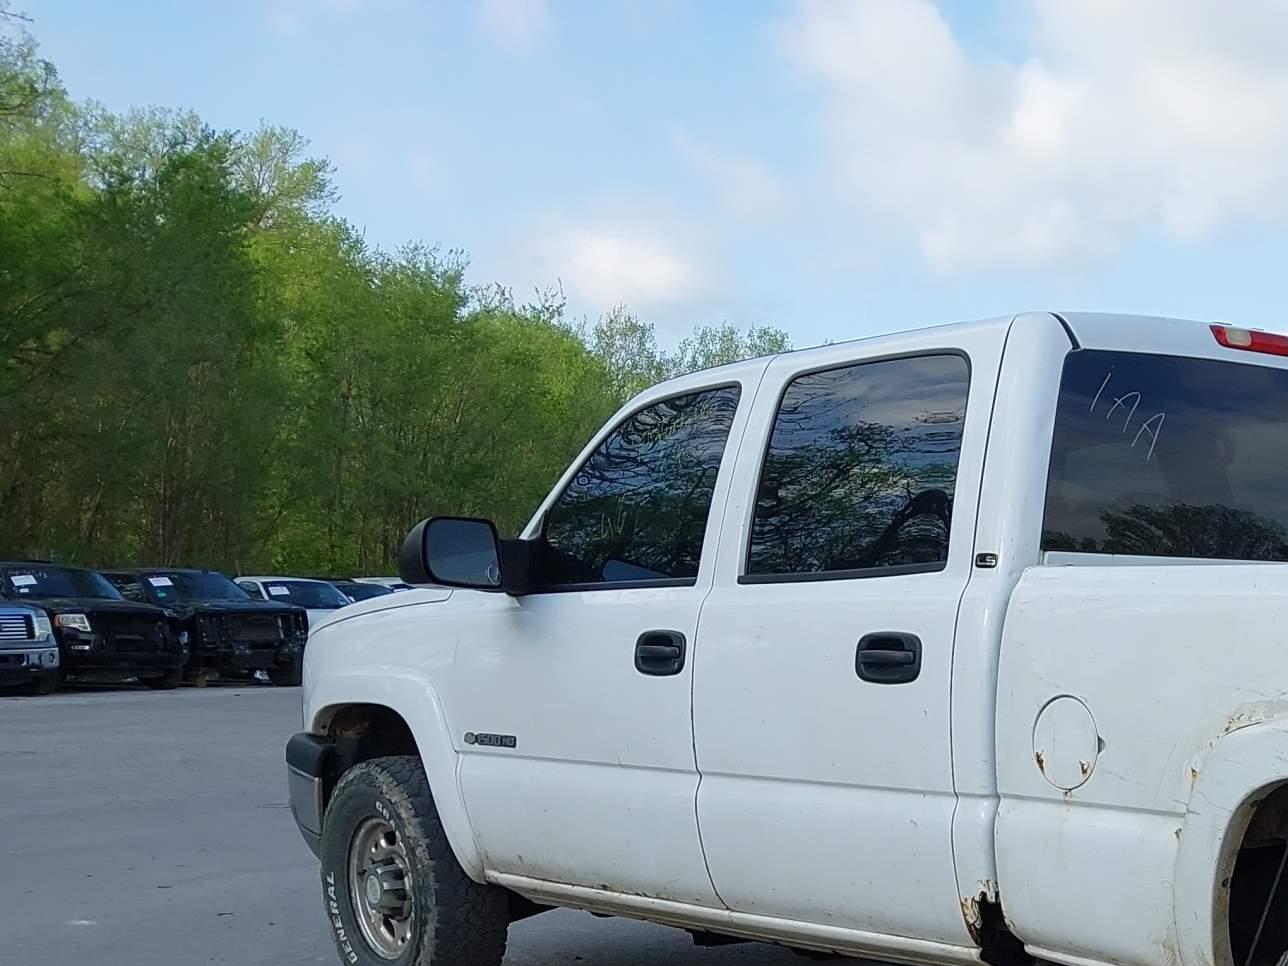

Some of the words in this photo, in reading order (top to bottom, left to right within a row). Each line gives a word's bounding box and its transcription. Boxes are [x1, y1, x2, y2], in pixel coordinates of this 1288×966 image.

[976, 554, 997, 567] LS
[502, 735, 515, 747] HD
[325, 871, 359, 965] GENERAL
